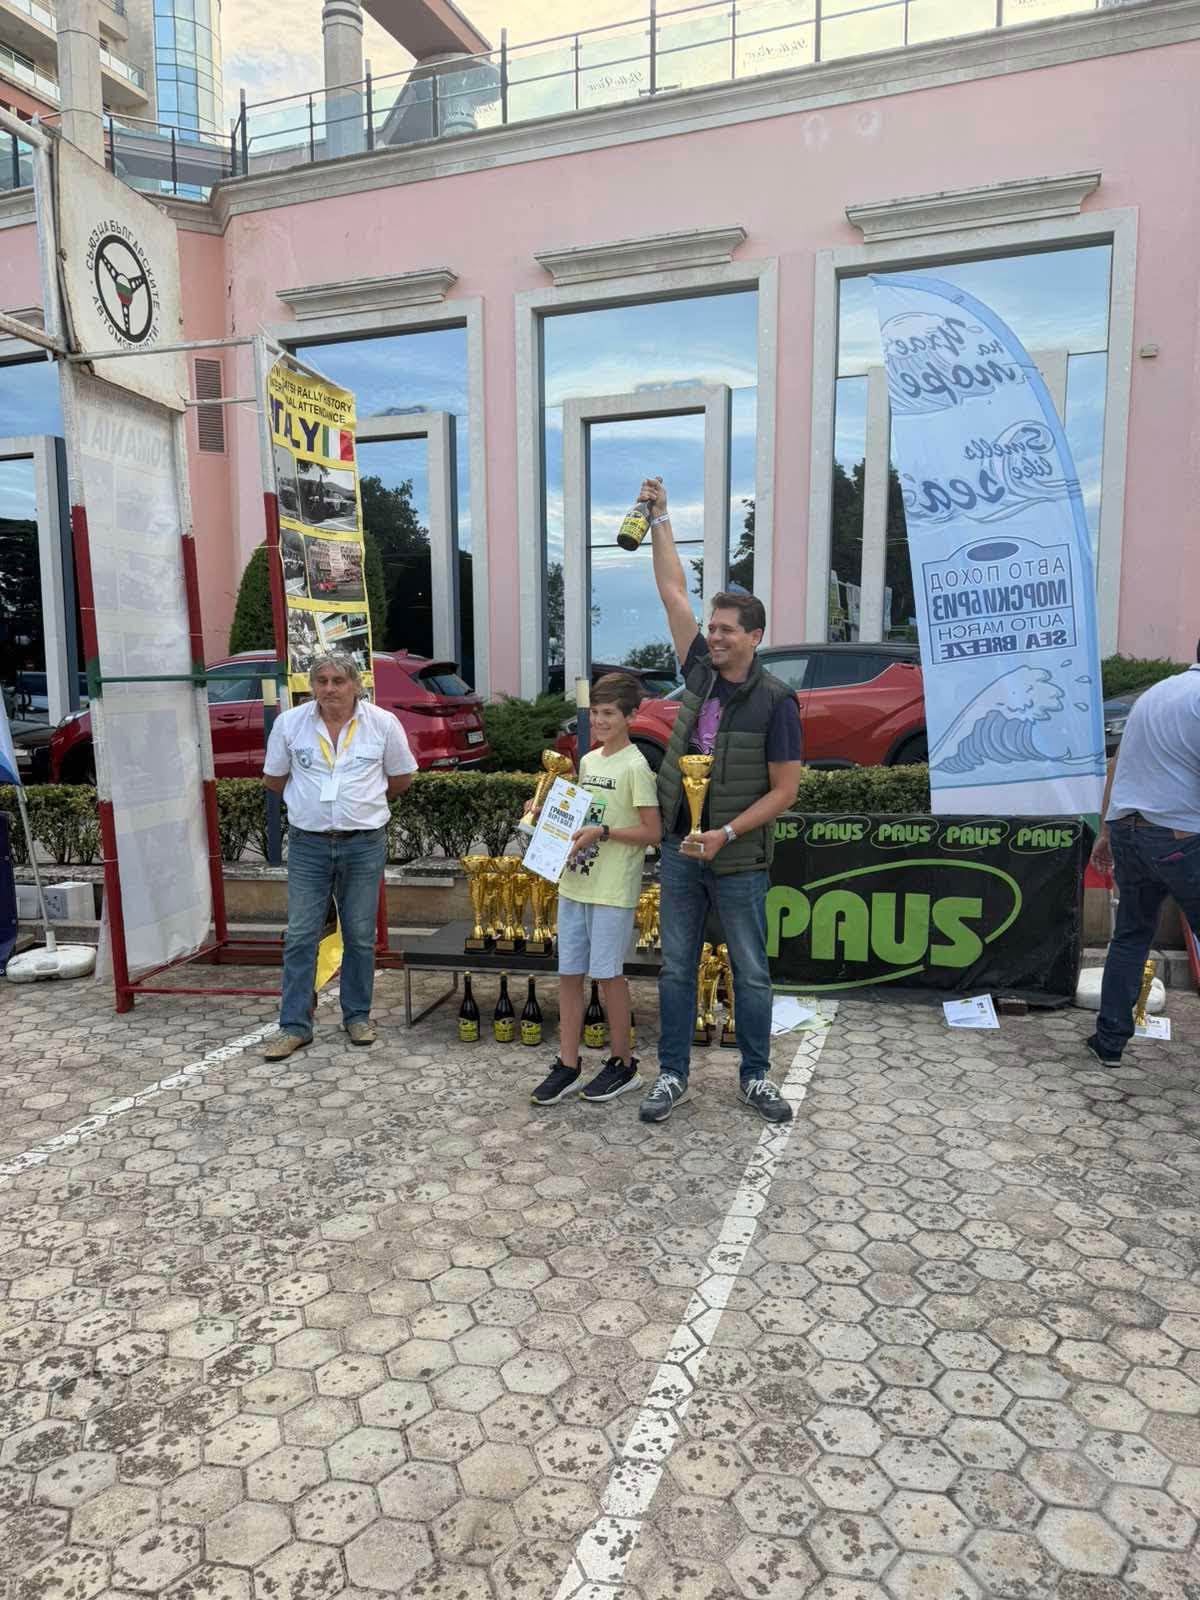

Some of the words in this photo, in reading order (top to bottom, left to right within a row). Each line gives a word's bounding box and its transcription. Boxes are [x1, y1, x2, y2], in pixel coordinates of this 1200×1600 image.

[297, 385, 323, 403] RALLY
[775, 822, 798, 839] US
[812, 822, 864, 842] PAUS
[878, 823, 931, 843] PAUS
[946, 825, 1001, 846] PAUS
[1016, 827, 1074, 848] PAUS
[766, 885, 984, 968] PAUS
